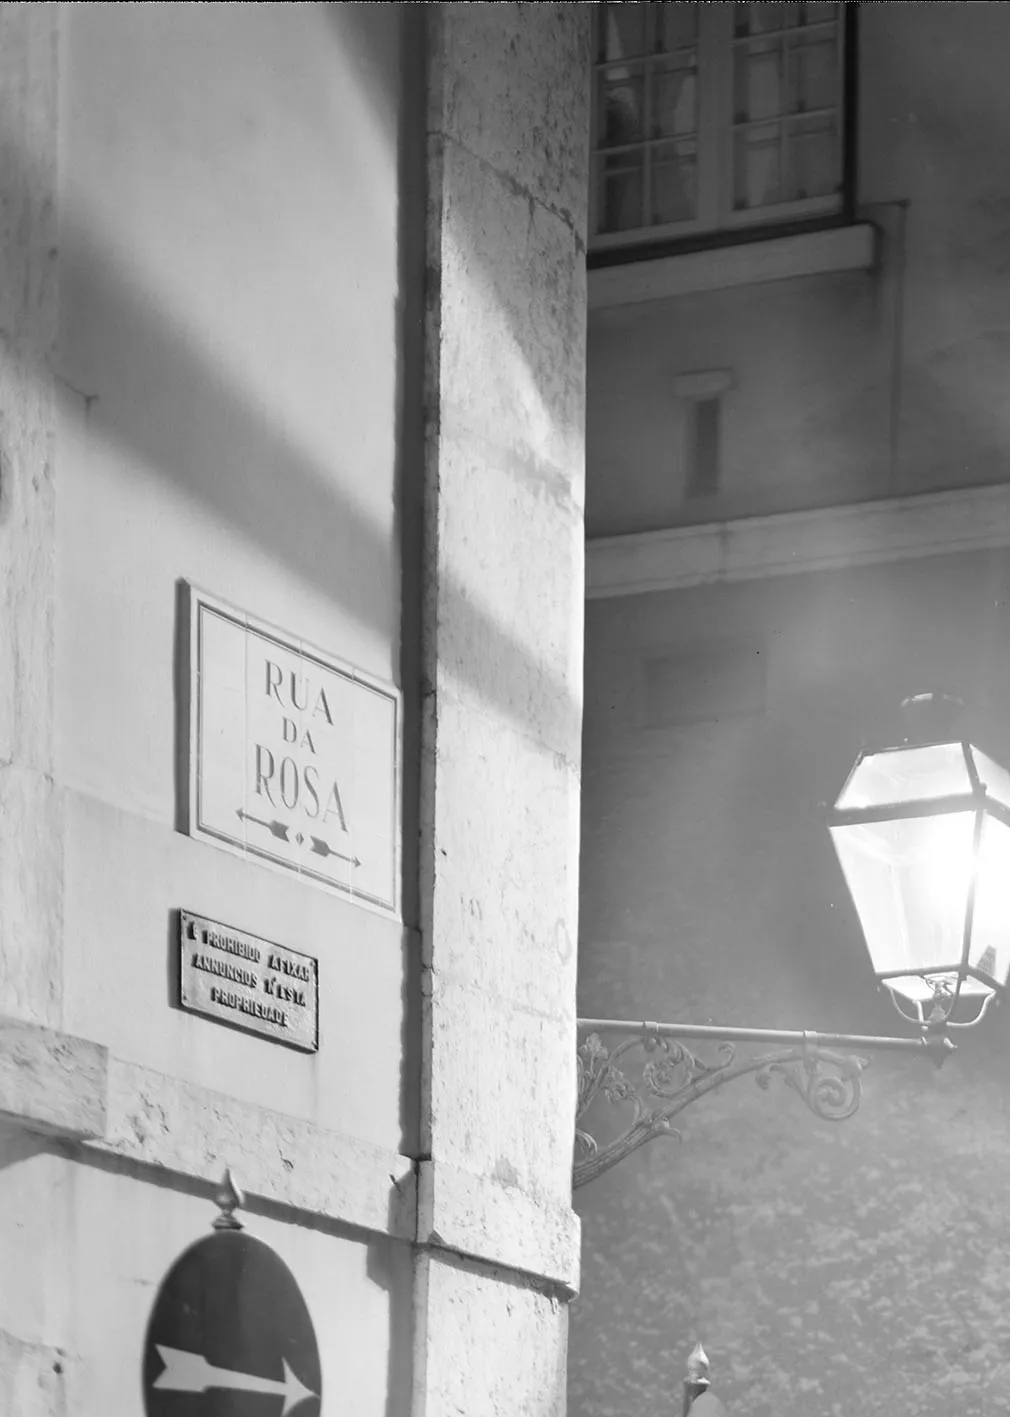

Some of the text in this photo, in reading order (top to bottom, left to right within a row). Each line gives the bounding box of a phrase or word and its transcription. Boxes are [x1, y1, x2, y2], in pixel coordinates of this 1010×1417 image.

[265, 659, 333, 726] RUA
[282, 717, 316, 754] DA
[255, 744, 348, 833] ROSA
